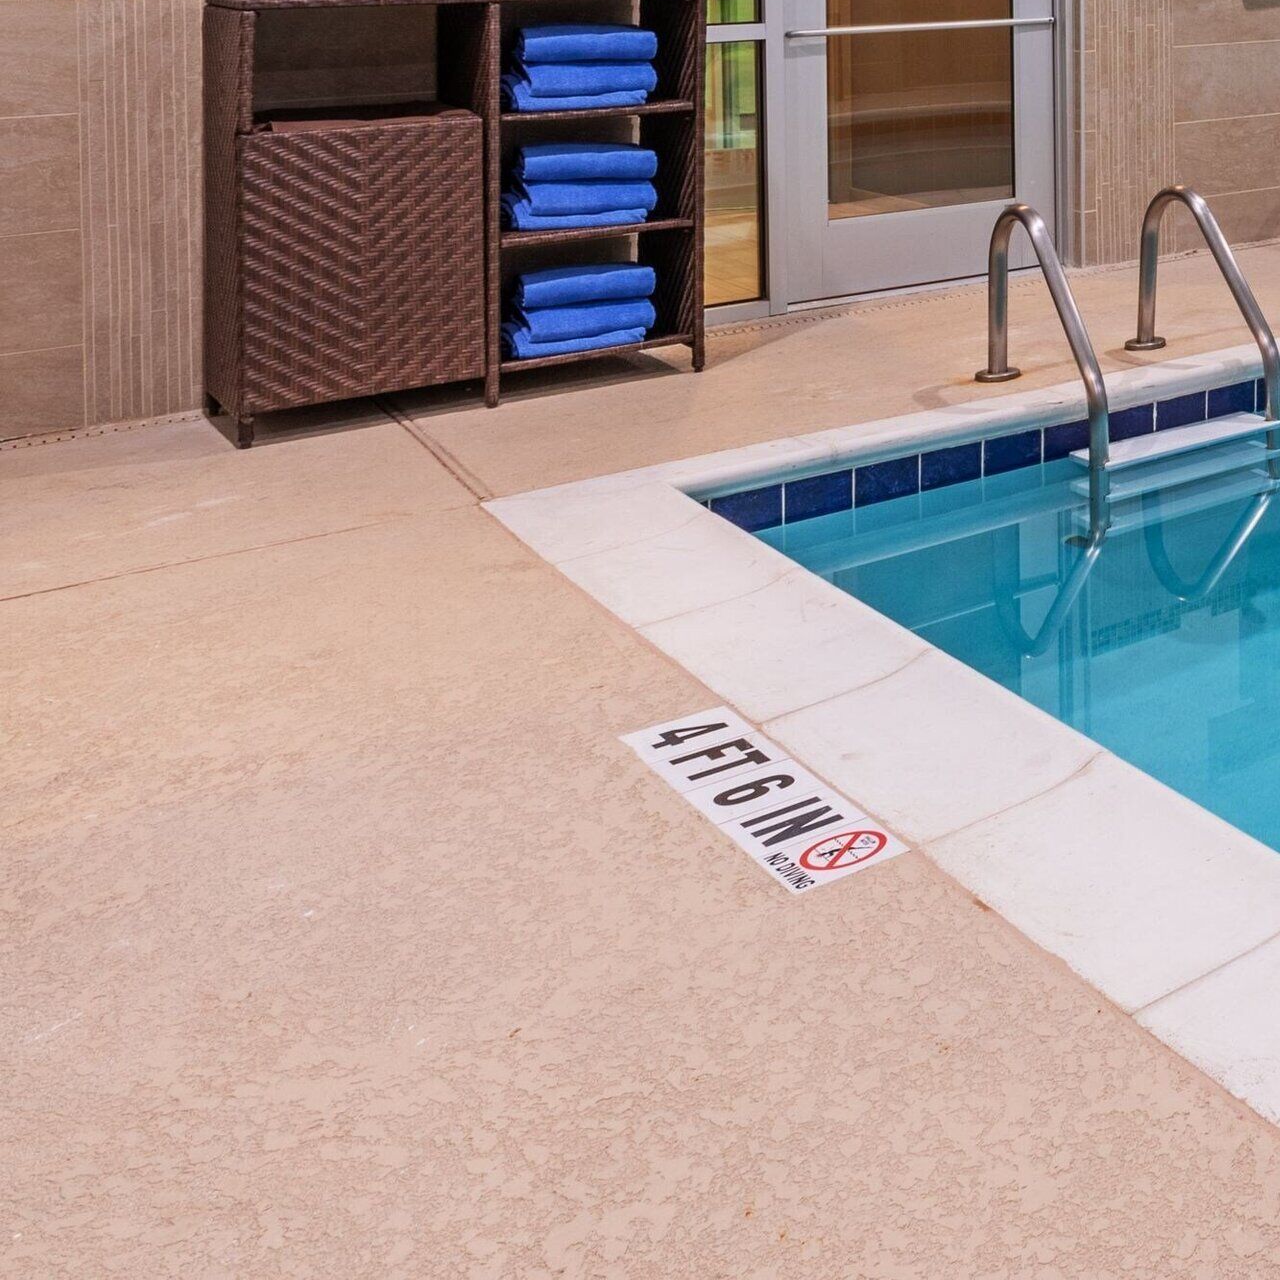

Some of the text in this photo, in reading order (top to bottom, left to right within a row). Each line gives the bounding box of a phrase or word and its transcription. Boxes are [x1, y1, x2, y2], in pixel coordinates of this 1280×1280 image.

[651, 722, 844, 848] 4 FT 6 IN
[764, 852, 816, 889] NO DIVING
